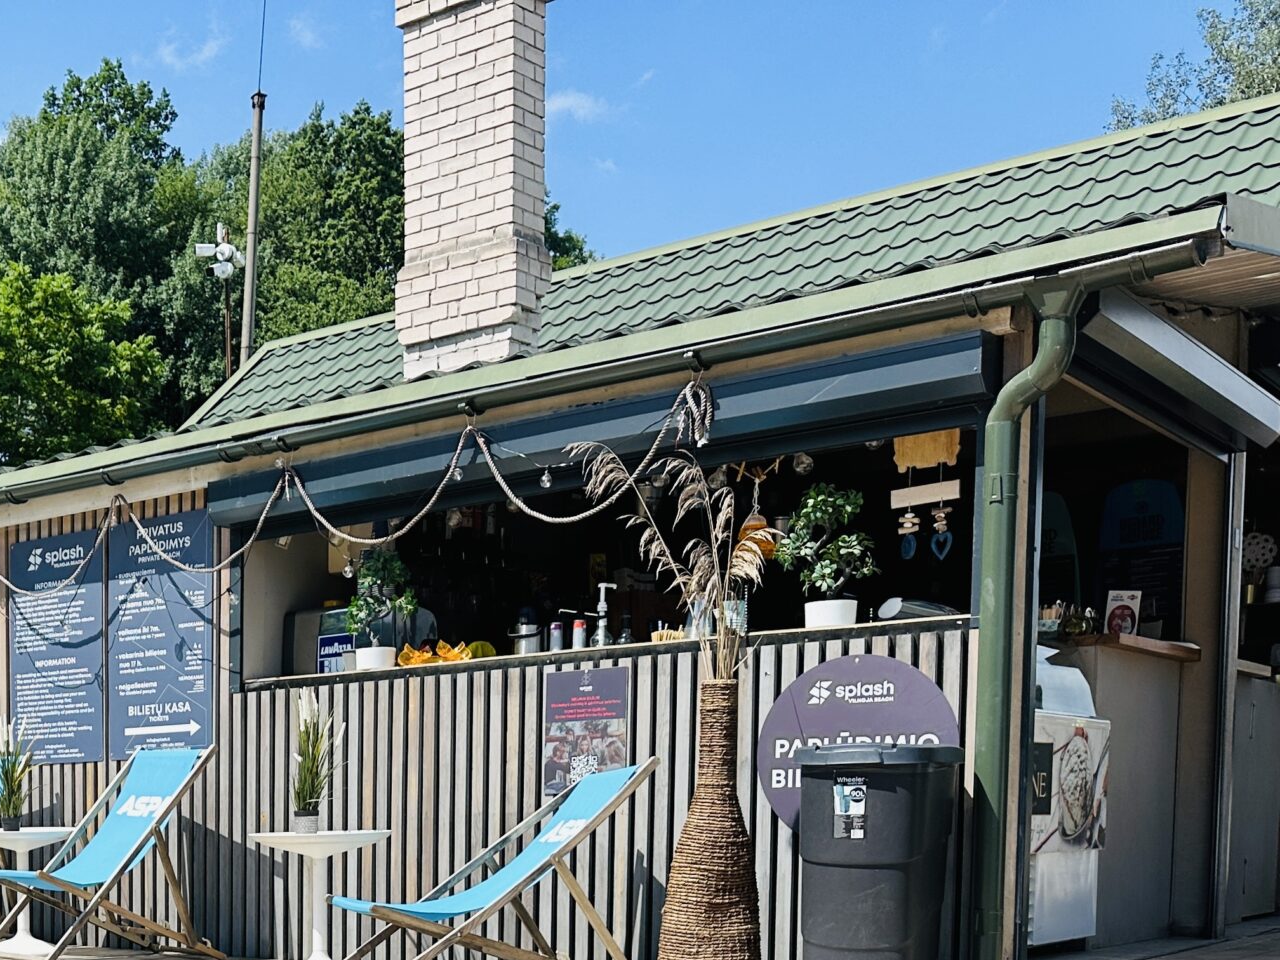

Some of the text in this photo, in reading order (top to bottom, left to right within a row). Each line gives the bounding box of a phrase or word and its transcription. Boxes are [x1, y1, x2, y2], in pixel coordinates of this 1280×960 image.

[136, 521, 184, 540] PRIVATUS
[44, 544, 84, 566] splash
[34, 578, 76, 591] INFORMACA
[320, 642, 352, 655] LAVAZZA
[34, 657, 77, 668] INFORMATION
[835, 680, 895, 702] splash
[127, 701, 192, 717] BILIETŲ KASA
